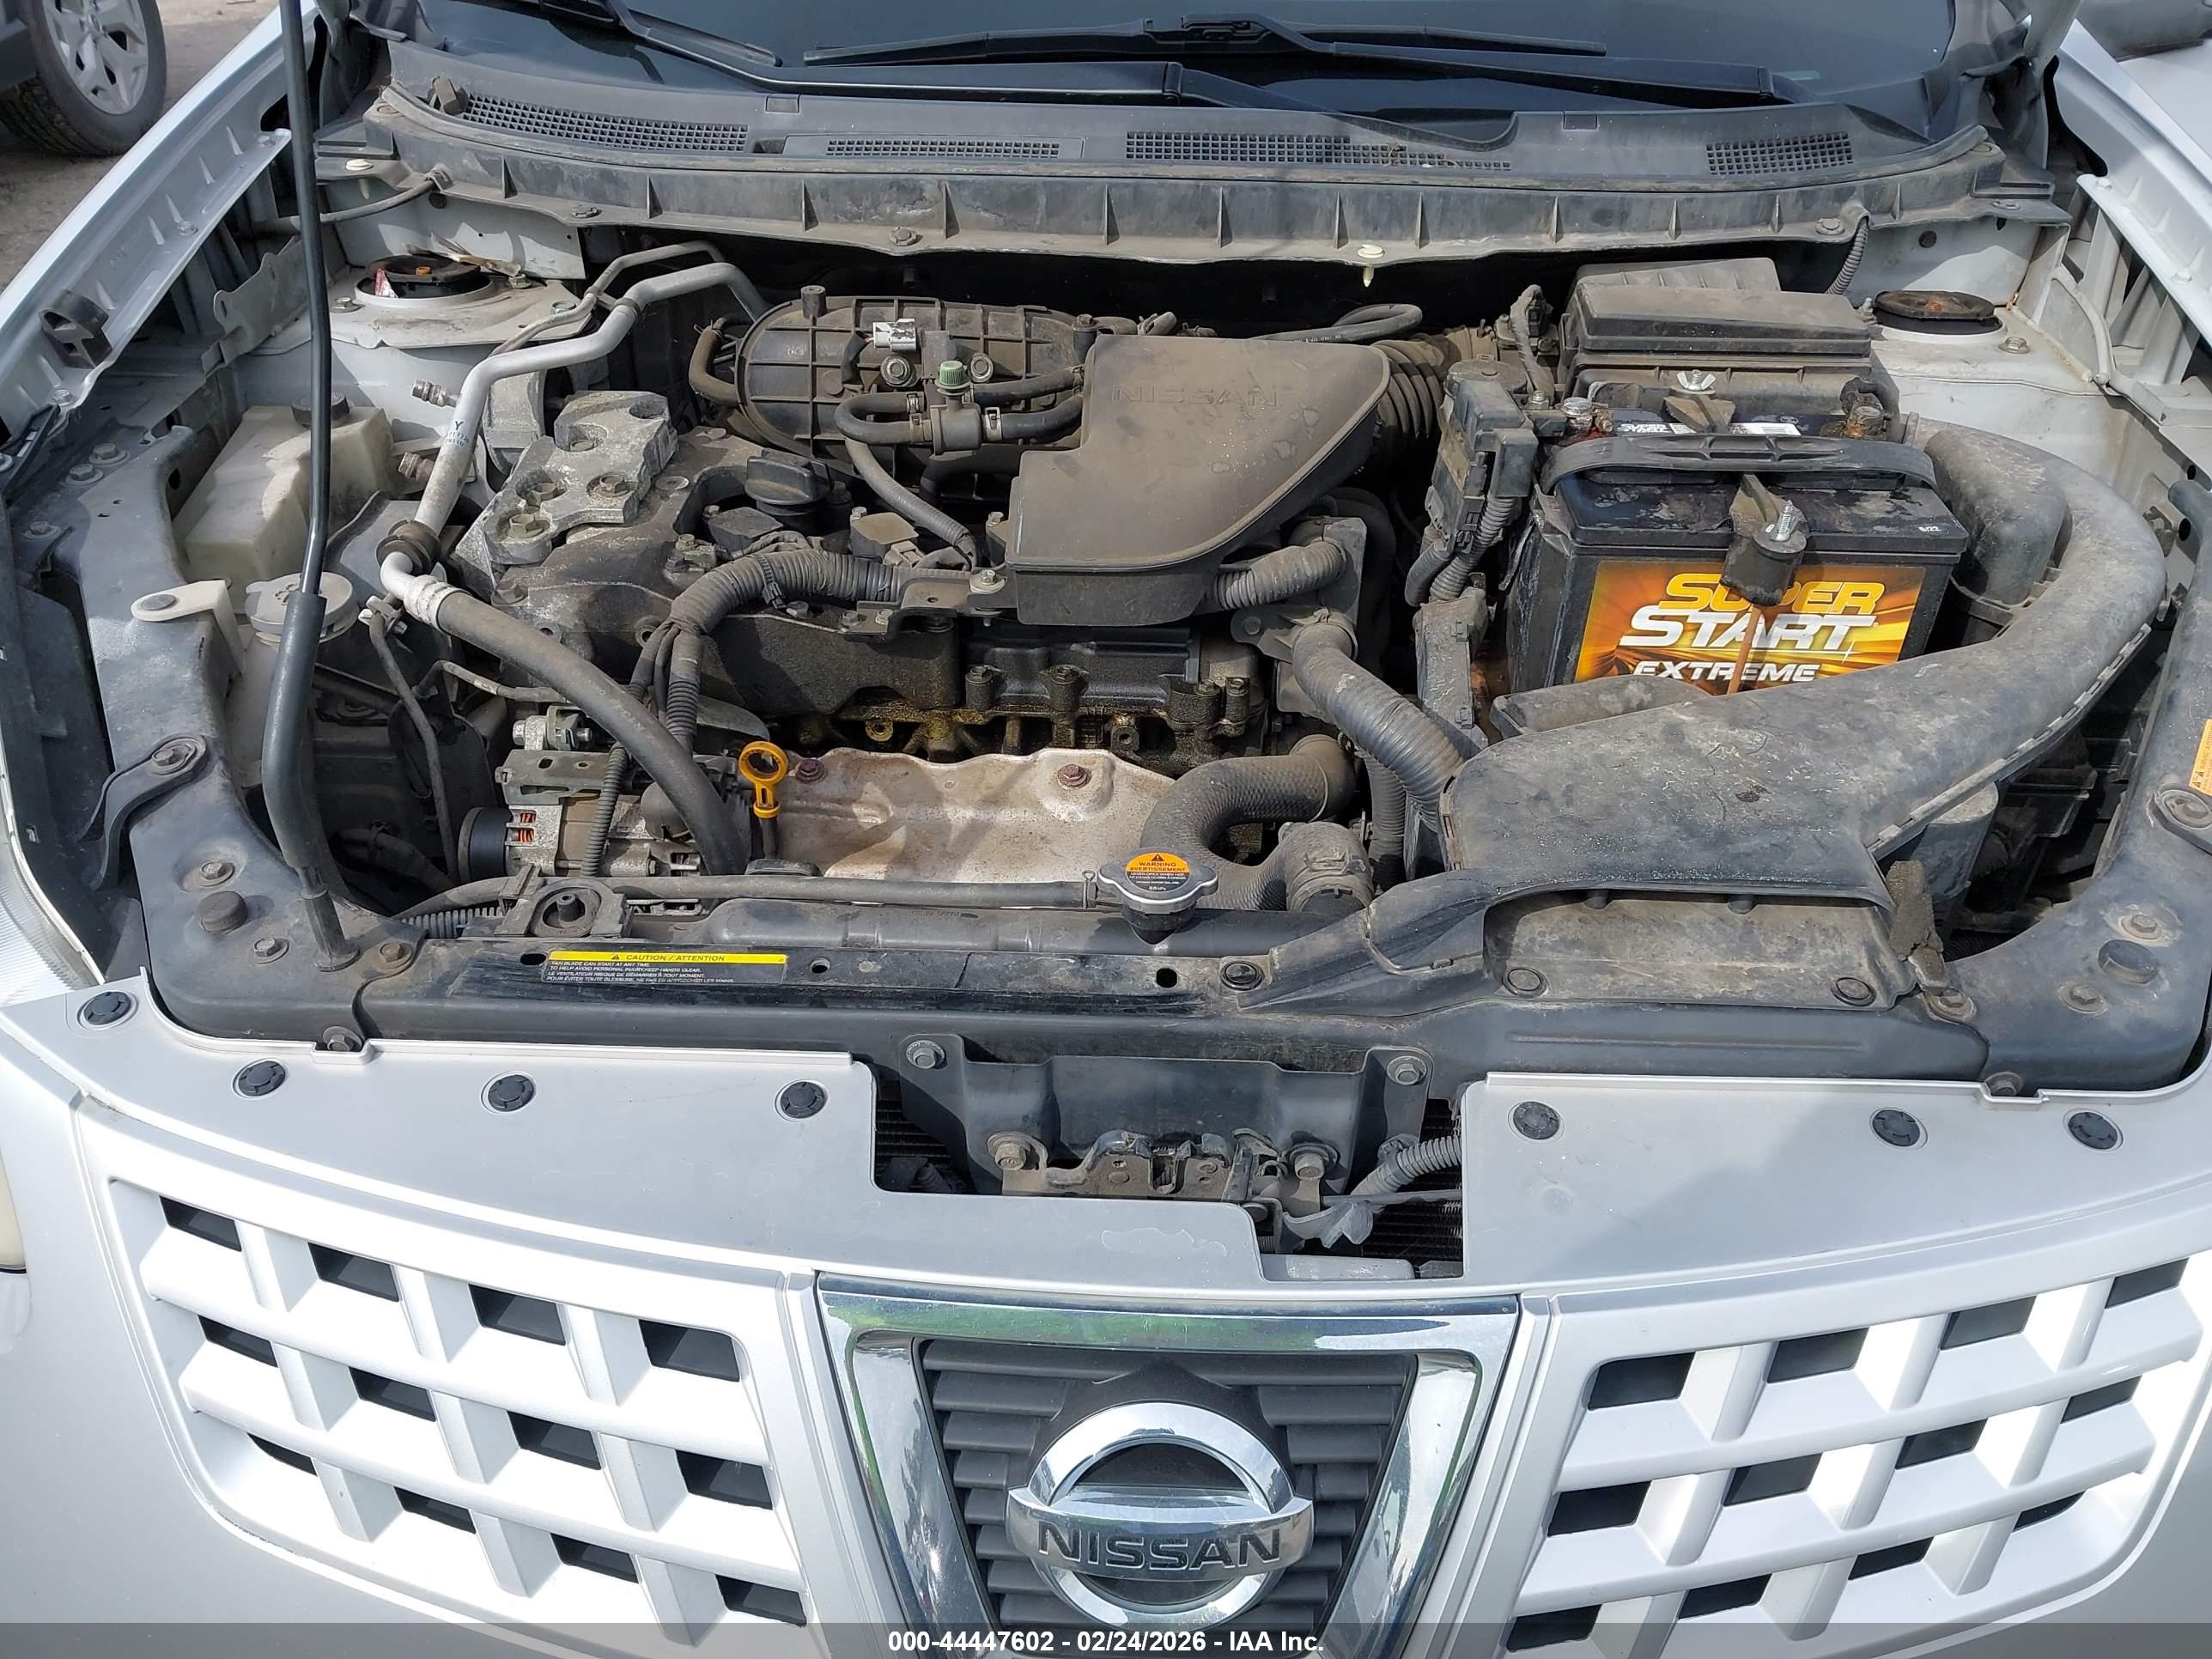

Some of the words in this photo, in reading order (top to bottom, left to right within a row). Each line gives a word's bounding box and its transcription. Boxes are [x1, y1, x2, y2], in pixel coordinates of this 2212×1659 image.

[1112, 386, 1277, 407] NISSAN
[1619, 605, 1877, 650] START
[1632, 660, 1821, 683] EXTREME
[1038, 1520, 1280, 1571] NISSAN
